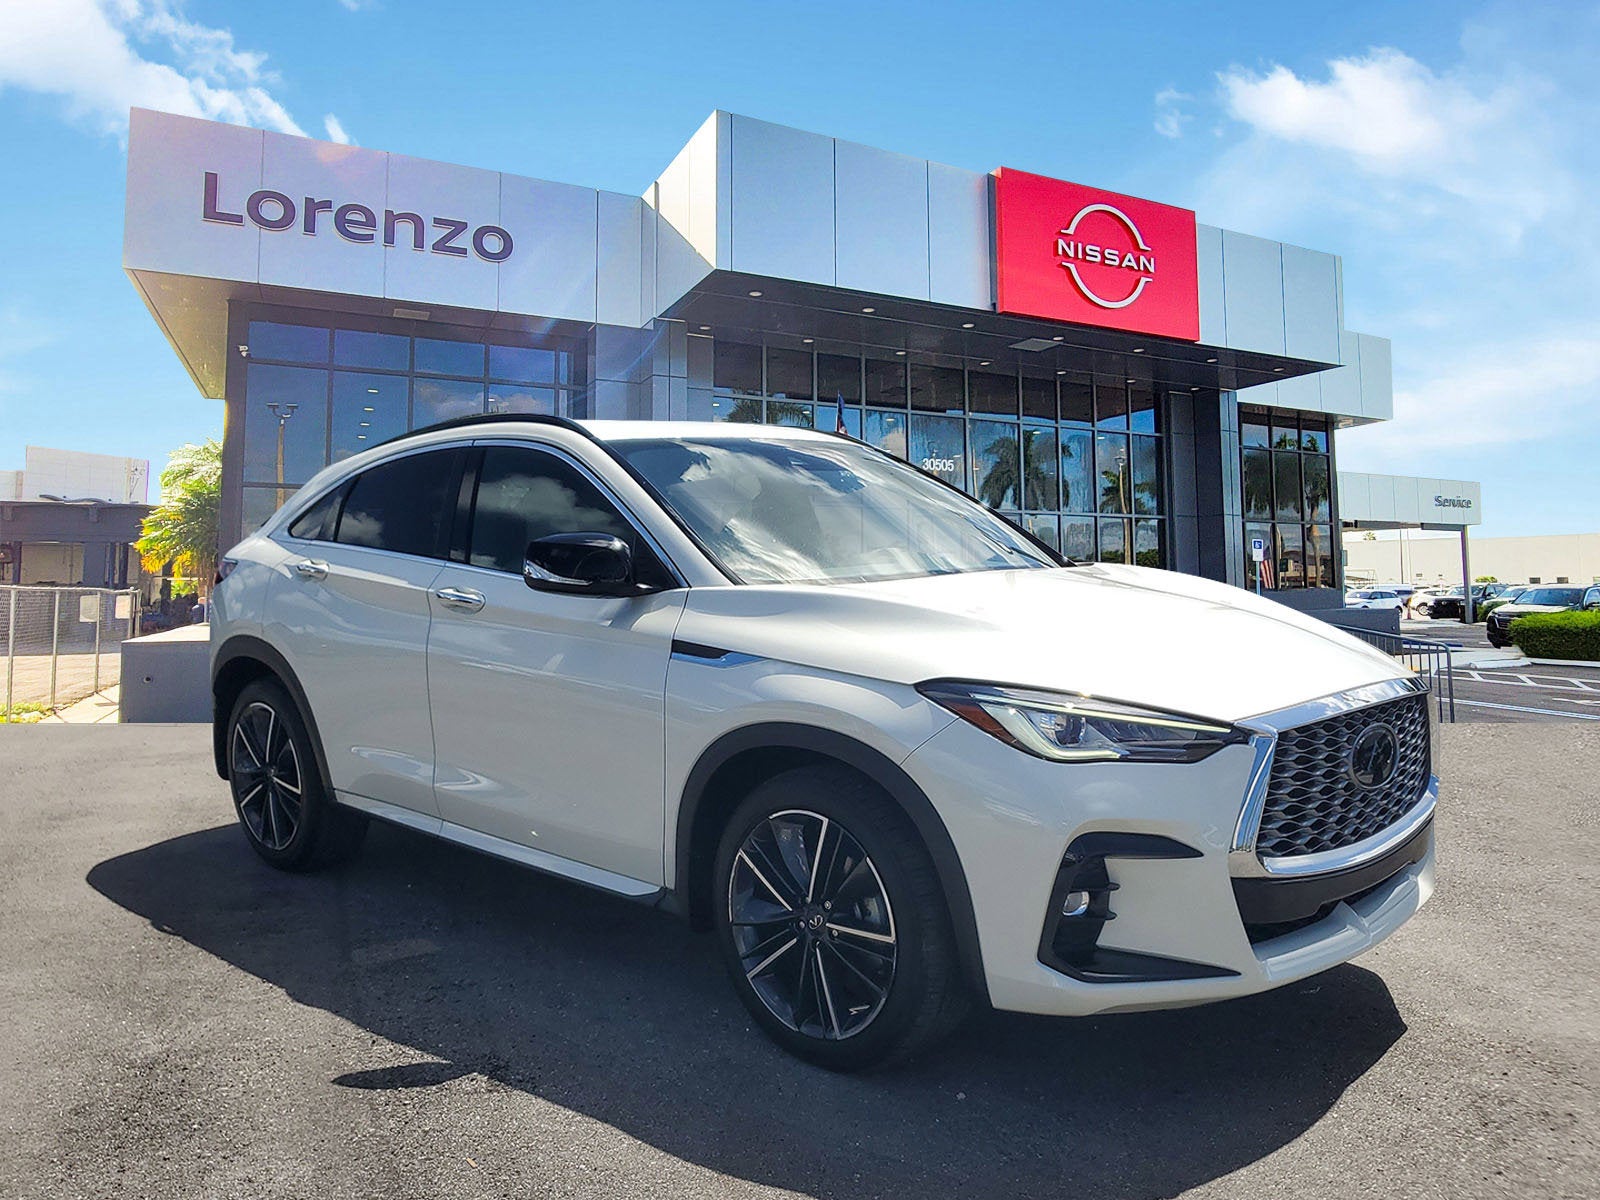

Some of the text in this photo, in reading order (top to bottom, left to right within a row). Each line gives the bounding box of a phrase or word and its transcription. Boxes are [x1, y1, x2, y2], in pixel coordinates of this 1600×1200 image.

[203, 171, 514, 262] Lorenzo
[1057, 238, 1155, 273] NISSAN
[922, 458, 955, 472] 30505
[1434, 495, 1472, 509] Service
